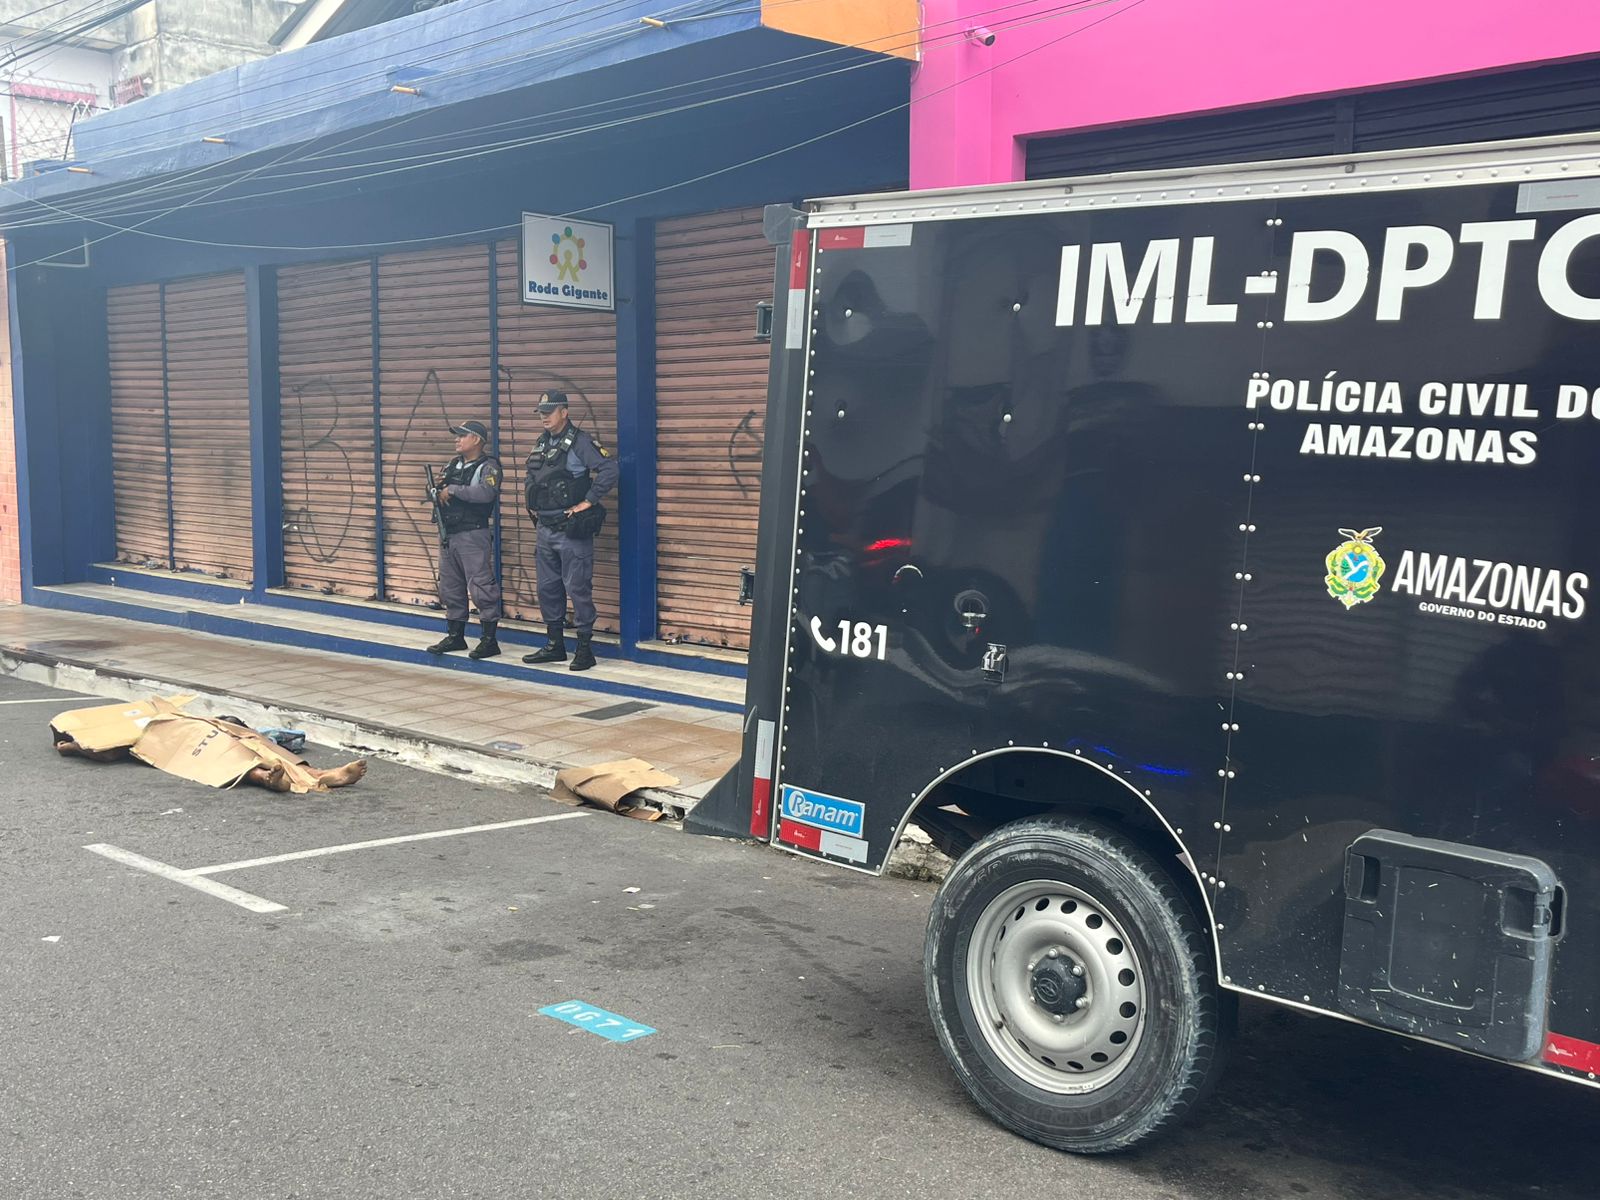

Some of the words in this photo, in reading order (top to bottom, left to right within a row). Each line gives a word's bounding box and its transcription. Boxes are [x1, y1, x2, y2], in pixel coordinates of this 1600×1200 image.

[529, 281, 559, 295] Roda
[562, 284, 608, 300] Gigante
[1246, 370, 1403, 413] POLÍCIA
[1419, 382, 1539, 417] CIVIL
[1300, 423, 1538, 465] AMAZONAS
[1391, 550, 1588, 619] AMAZONAS
[1419, 602, 1475, 619] GOVERNO
[1477, 611, 1495, 622] DO
[1498, 613, 1547, 630] ESTADO
[837, 619, 888, 661] 181
